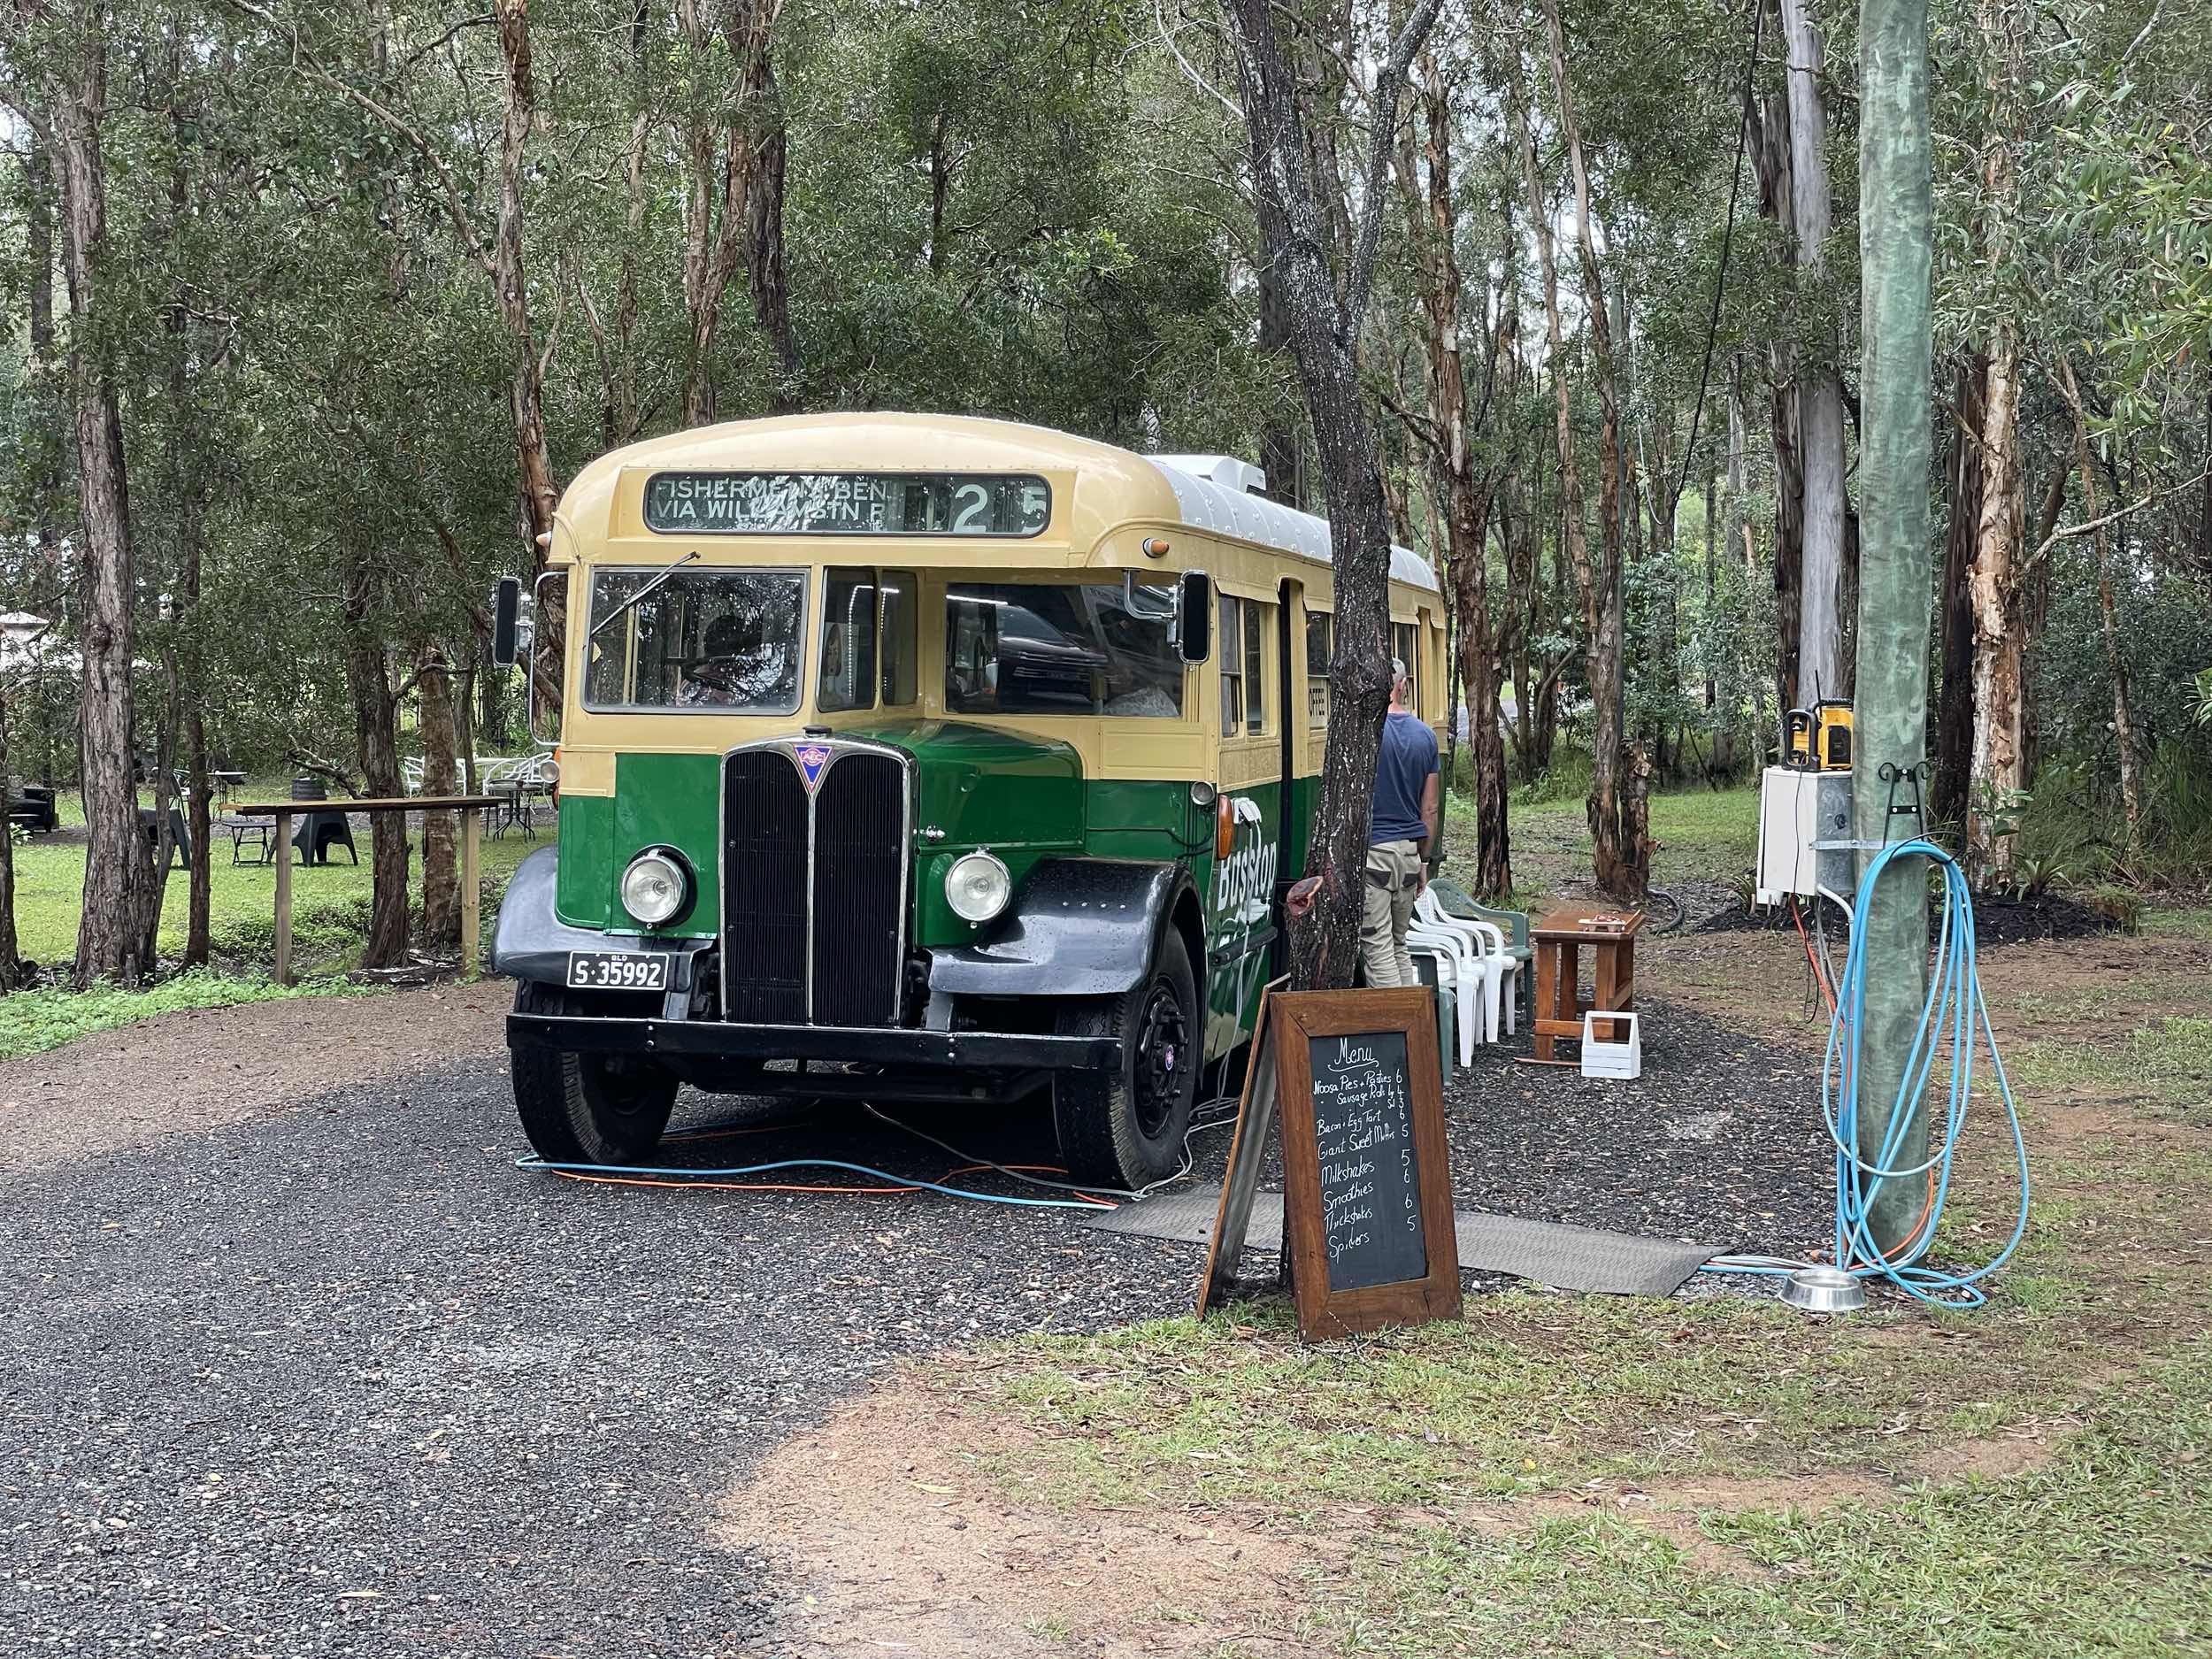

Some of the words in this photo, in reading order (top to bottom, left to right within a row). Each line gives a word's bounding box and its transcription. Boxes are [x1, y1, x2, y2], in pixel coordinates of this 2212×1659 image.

[657, 500, 696, 518] VIA
[708, 500, 859, 520] WILLAMSTN
[1334, 1037, 1375, 1064] Menu
[1313, 1080, 1339, 1094] Noosa
[1340, 1075, 1358, 1090] Pies
[1363, 1070, 1392, 1085] Pasties
[1396, 1069, 1402, 1083] 6
[1337, 1093, 1369, 1107] Sausage
[1397, 1085, 1404, 1098] 4
[1398, 1098, 1404, 1108] 3
[1317, 1119, 1341, 1136] Bacon
[1348, 1113, 1362, 1132] Egg
[1363, 1109, 1381, 1122] Tart
[1400, 1109, 1405, 1119] 6
[1318, 1137, 1346, 1159] Giant
[1349, 1127, 1372, 1150] Sweet
[1402, 1124, 1408, 1137] 5
[1322, 1155, 1374, 1187] Milkshakes
[1402, 1149, 1410, 1166] 5
[1324, 1182, 1373, 1211] Smoothies
[1404, 1168, 1409, 1183] 6
[1405, 1193, 1412, 1209] 6
[1329, 1226, 1369, 1264] Spiders
[1407, 1215, 1416, 1231] 5
